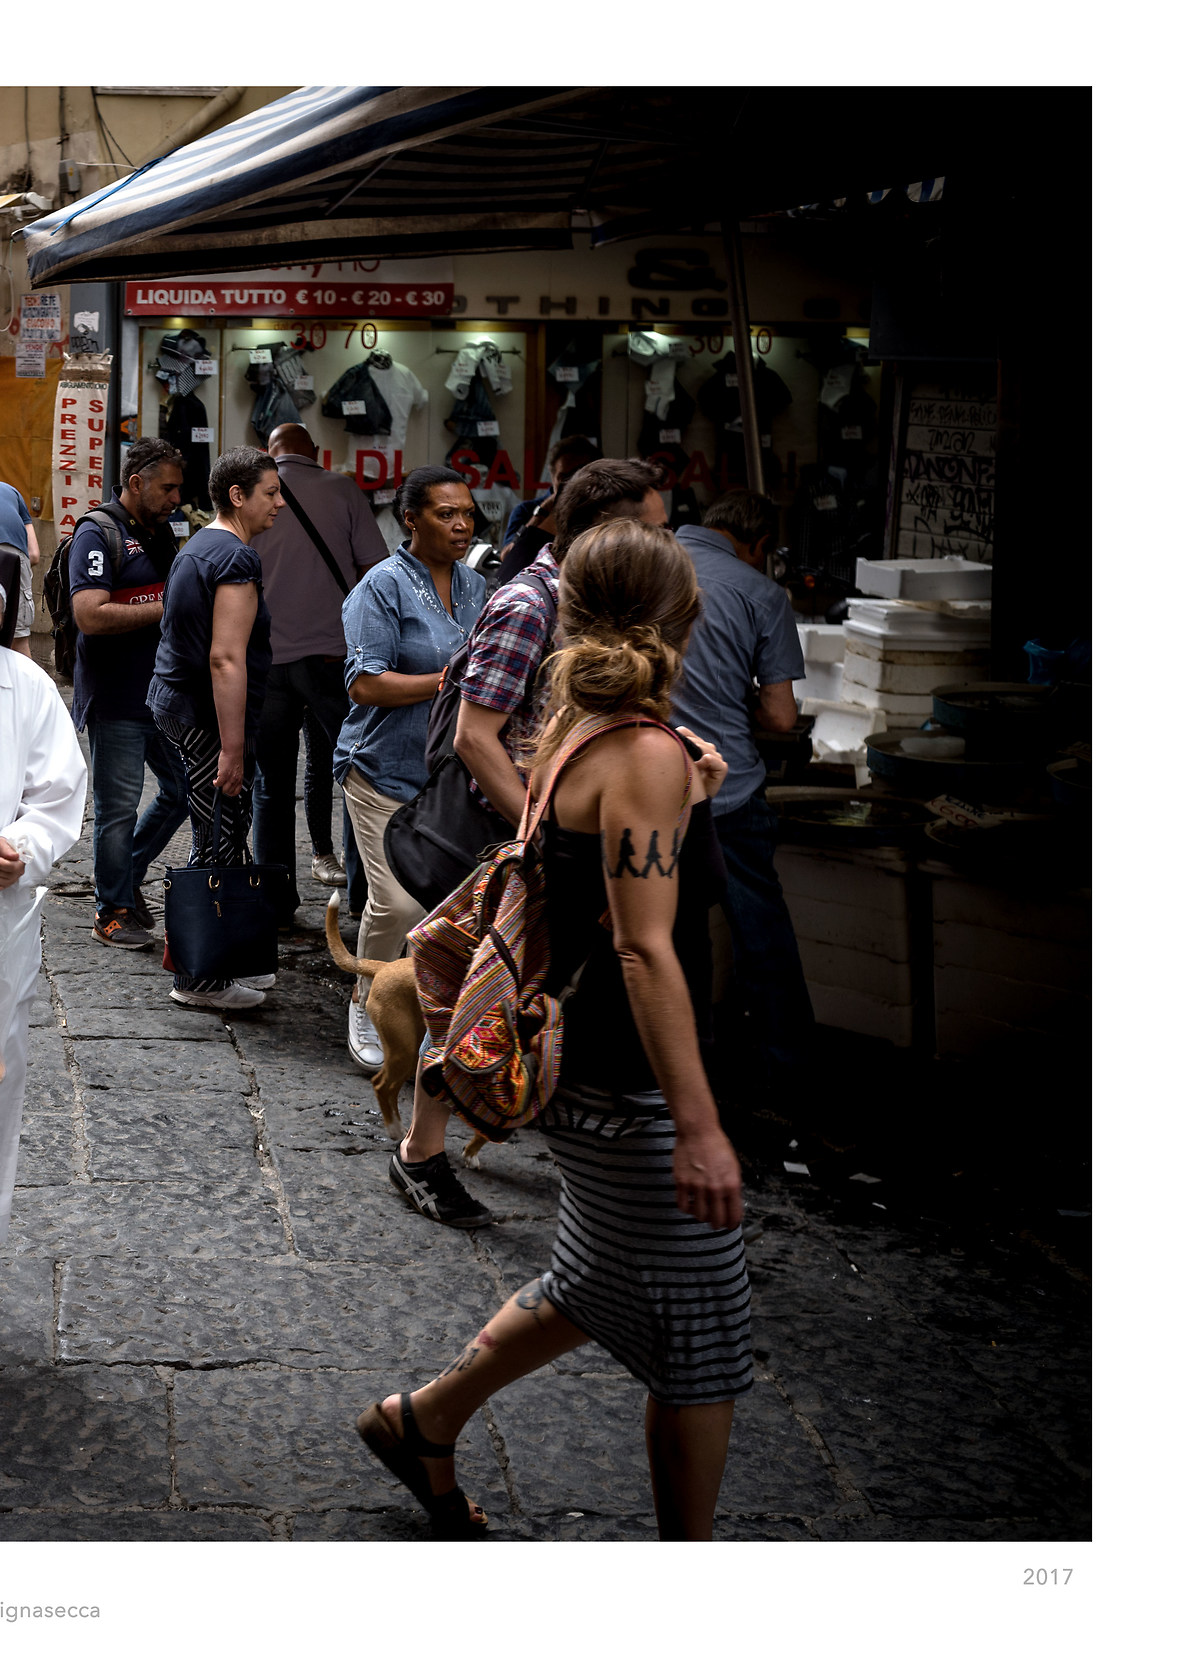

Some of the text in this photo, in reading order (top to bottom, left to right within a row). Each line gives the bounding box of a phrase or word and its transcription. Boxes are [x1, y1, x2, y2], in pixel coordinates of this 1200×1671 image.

[136, 289, 216, 307] LIQUIDA
[221, 289, 287, 306] TUTTO
[295, 289, 309, 305] €
[312, 289, 337, 305] 10
[351, 290, 365, 306] €
[367, 290, 392, 306] 20
[405, 290, 419, 307] €
[422, 290, 446, 306] 30
[59, 397, 77, 486] PREZZI
[88, 400, 104, 489] SUPER
[88, 550, 104, 577] 3
